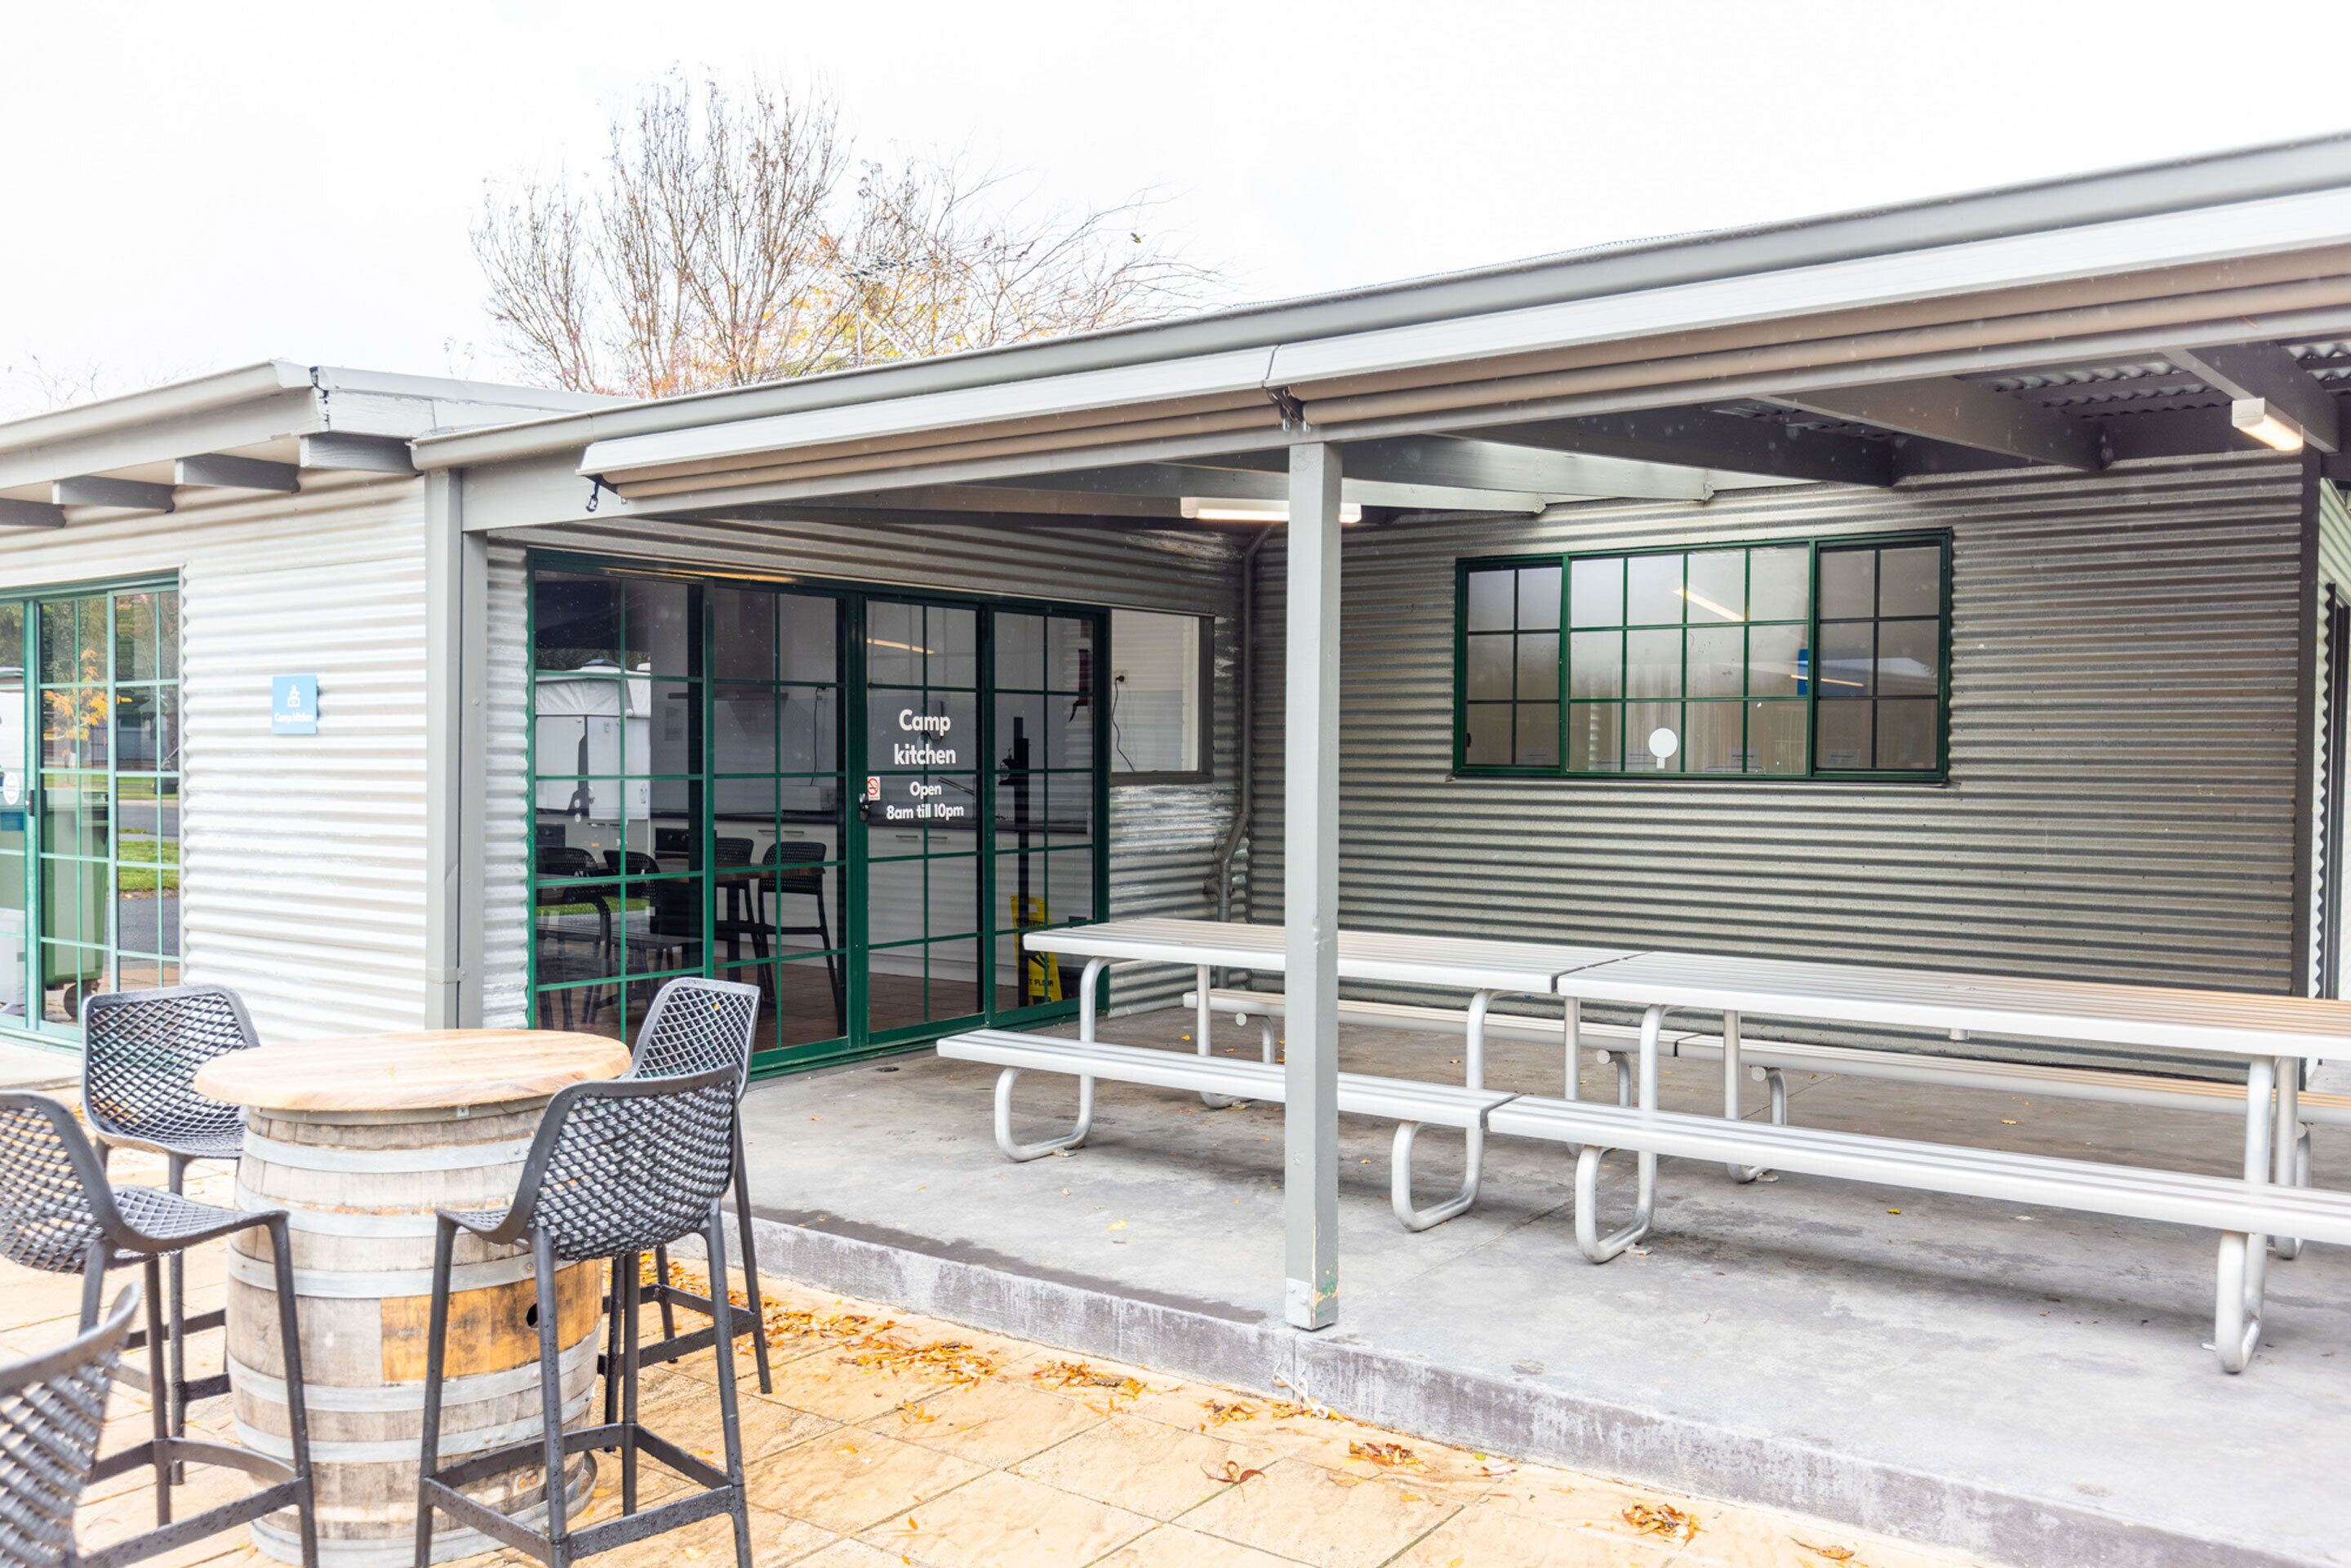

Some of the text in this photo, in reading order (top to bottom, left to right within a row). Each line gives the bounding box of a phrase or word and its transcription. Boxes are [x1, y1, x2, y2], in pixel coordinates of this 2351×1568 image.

[899, 708, 951, 736] Camp
[894, 744, 956, 765] kitchen
[909, 781, 941, 799] Open
[887, 803, 964, 820] 8am till 10pm
